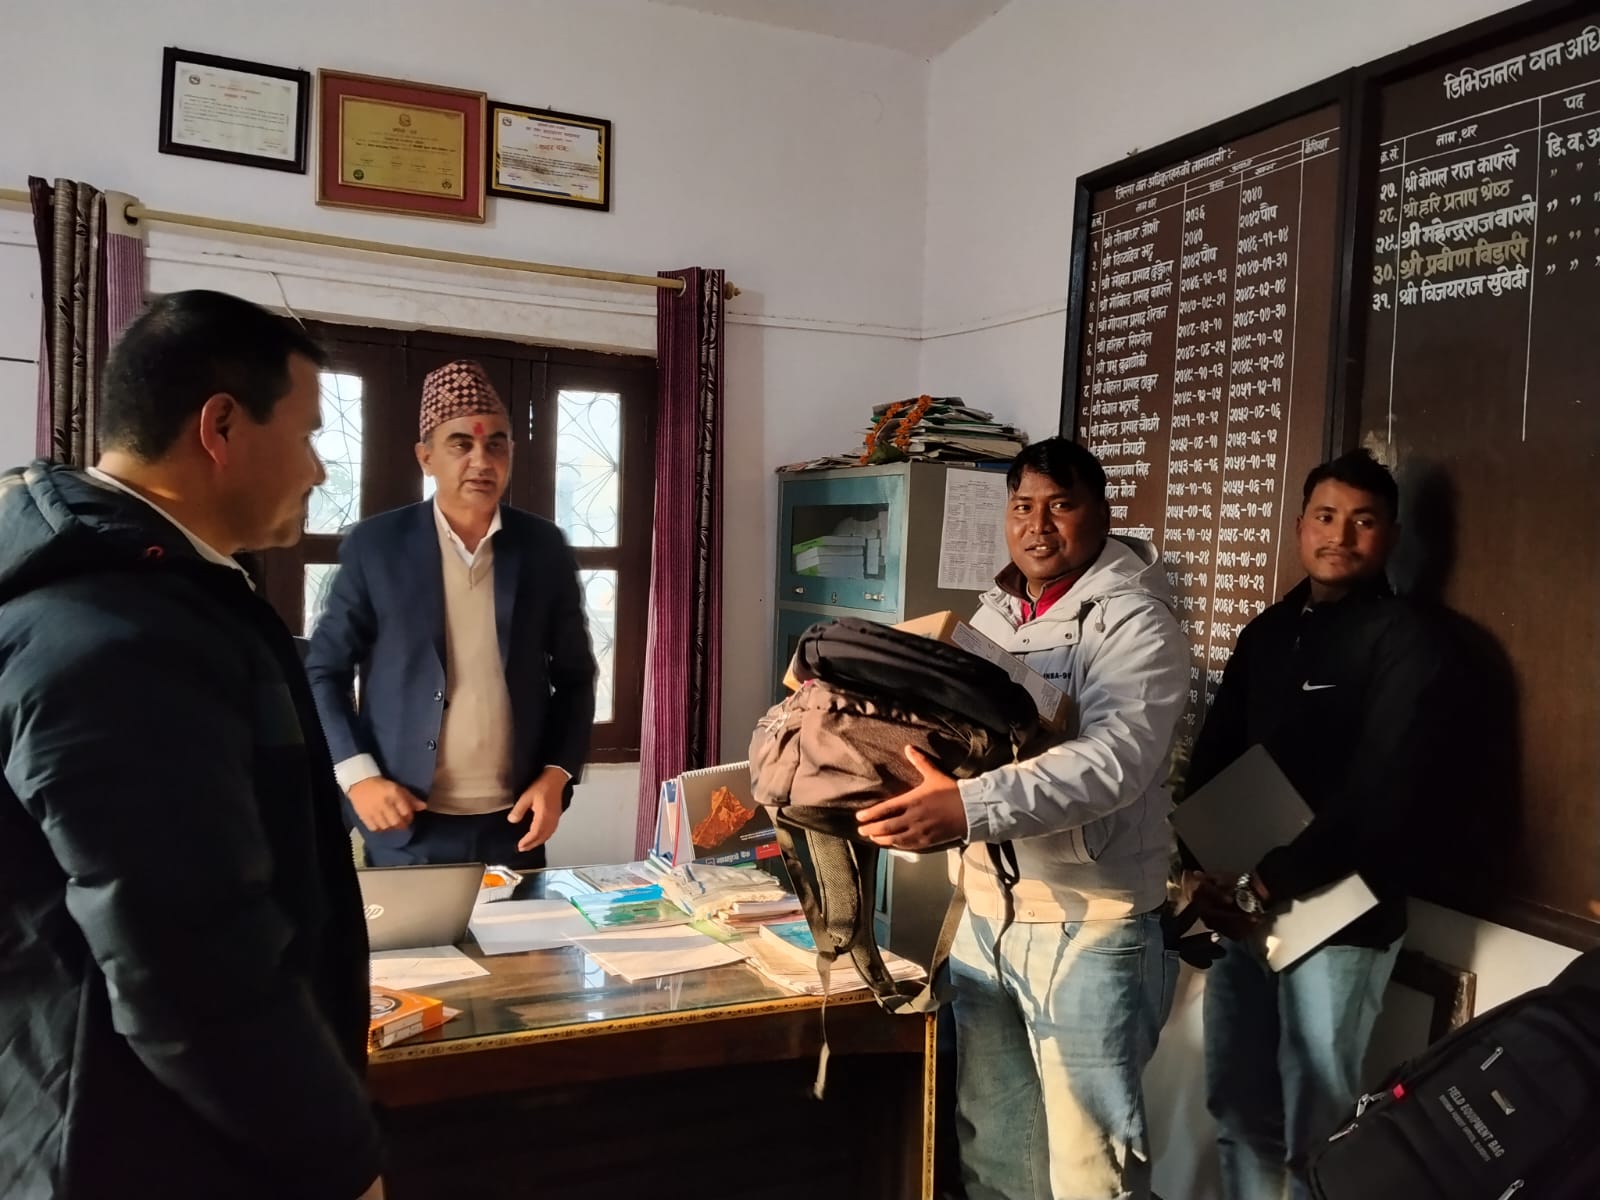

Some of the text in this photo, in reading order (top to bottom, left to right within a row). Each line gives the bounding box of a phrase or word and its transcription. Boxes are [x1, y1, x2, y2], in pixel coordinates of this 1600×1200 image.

[1443, 54, 1527, 99] डिभिजनल
[1529, 42, 1565, 71] वन
[1563, 92, 1586, 109] पद
[1405, 170, 1418, 193] श्री
[1418, 166, 1449, 188] कोमल
[1451, 160, 1476, 180] राज
[1403, 197, 1419, 218] श्री
[1419, 192, 1441, 219] हरि
[1443, 187, 1479, 212] प्रताप
[1481, 177, 1514, 203] श्रेष्ठ
[1104, 232, 1113, 249] श्री
[1241, 186, 1263, 205] २०४०
[1401, 221, 1421, 249] श्री
[1103, 253, 1112, 270] श्री
[1400, 249, 1424, 280] श्री
[1424, 246, 1474, 277] प्रवीण
[1102, 273, 1110, 290] श्री
[1399, 281, 1419, 305] श्री
[1099, 295, 1108, 312] श्री
[1098, 317, 1107, 332] श्री
[1097, 337, 1106, 353] श्री
[1096, 359, 1106, 374] श्री
[1093, 379, 1102, 395] श्री
[1093, 399, 1101, 416] श्री
[1447, 1086, 1466, 1105] FIELD
[1460, 1103, 1494, 1141] EQUIPMENT
[1488, 1140, 1504, 1157] BAG
